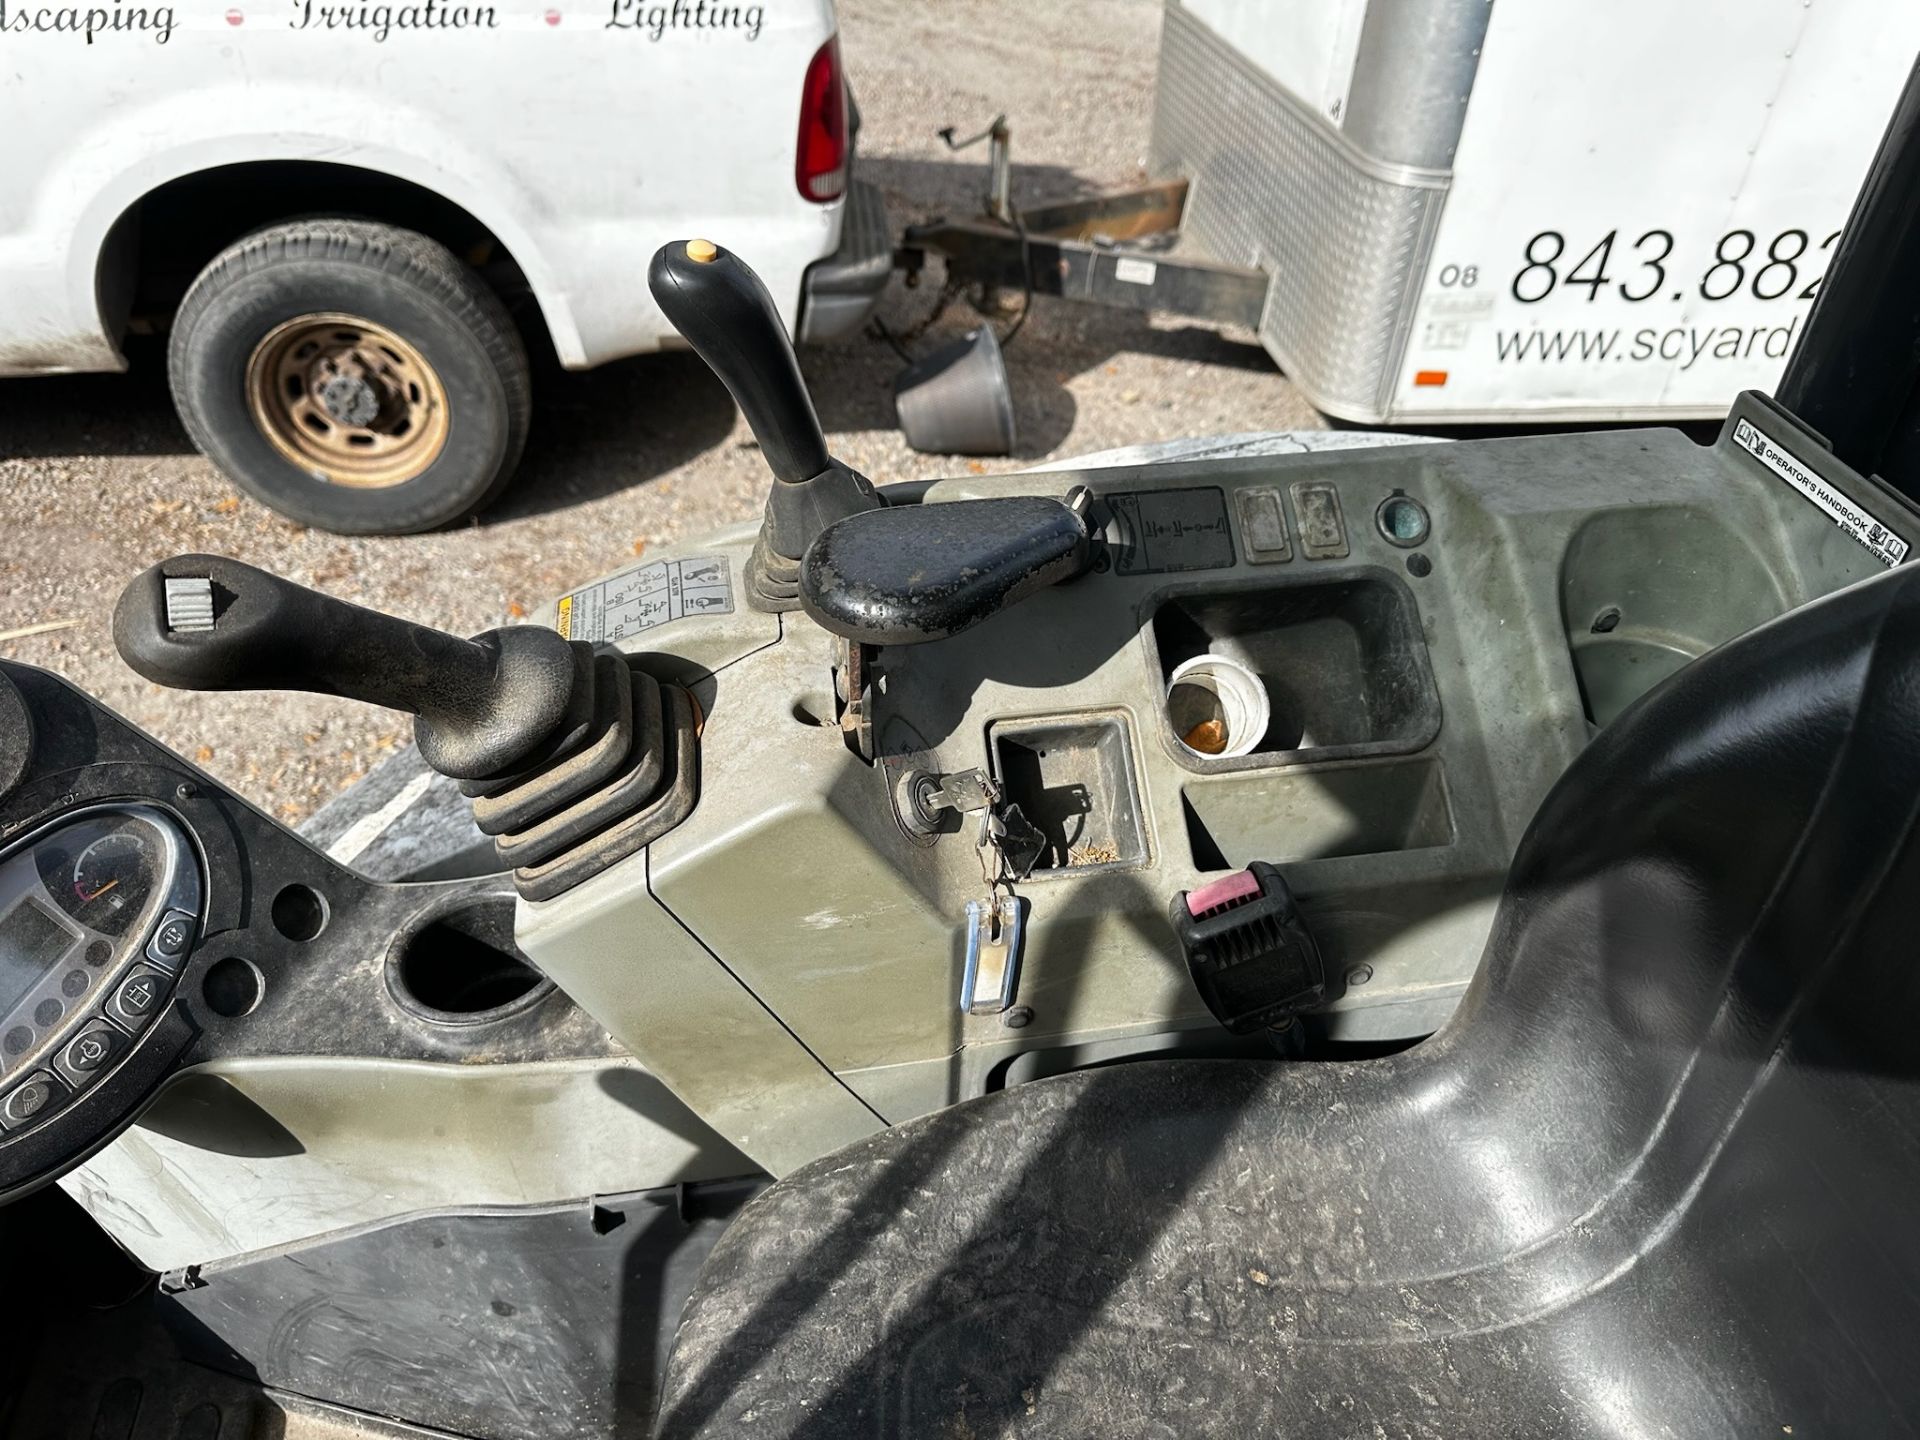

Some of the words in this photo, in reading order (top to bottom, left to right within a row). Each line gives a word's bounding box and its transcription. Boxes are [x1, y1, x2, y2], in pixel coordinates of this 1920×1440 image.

[289, 0, 500, 43] Irrigation
[605, 0, 764, 42] Lighting
[1766, 449, 1817, 492] OPERATOR'S
[1817, 486, 1868, 533] HANDBOOK
[559, 606, 570, 640] ARNING
